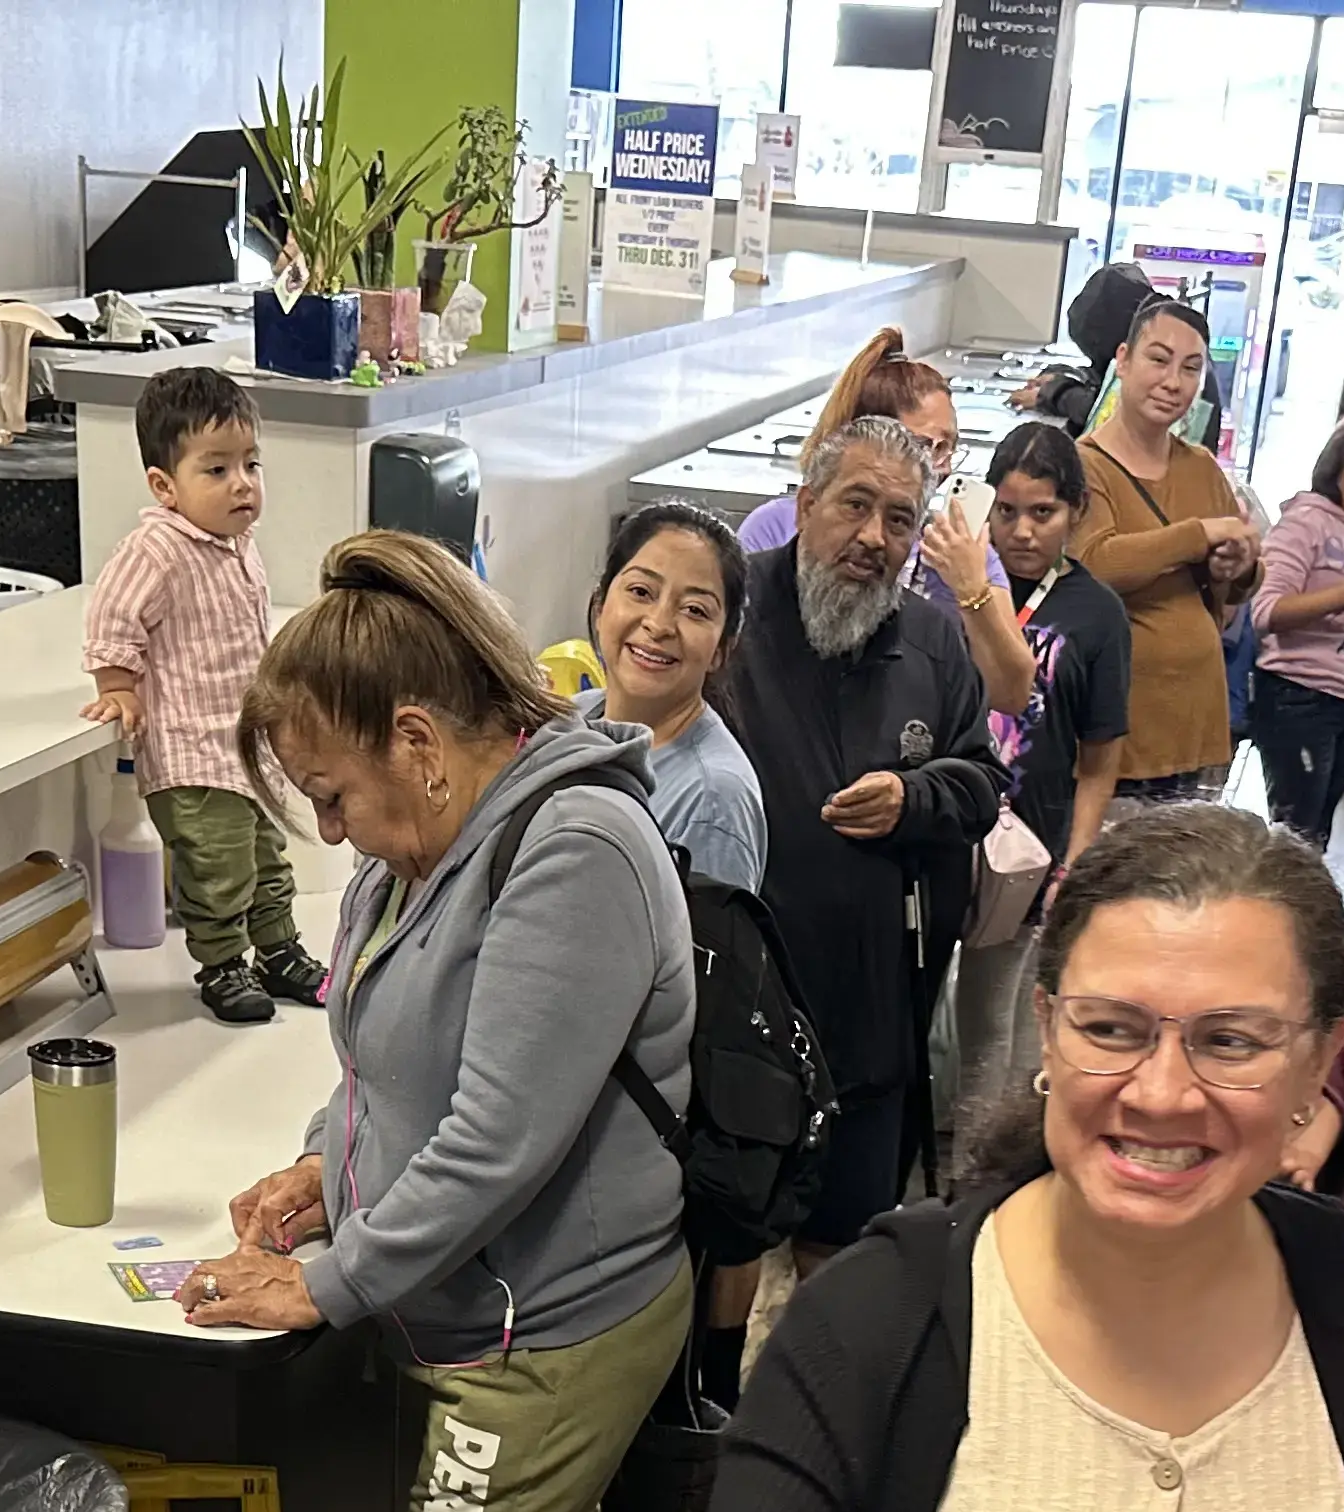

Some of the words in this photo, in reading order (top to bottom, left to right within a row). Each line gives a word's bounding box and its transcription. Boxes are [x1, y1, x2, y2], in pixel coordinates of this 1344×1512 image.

[623, 128, 662, 153] HALF
[662, 131, 707, 157] PRICE
[615, 152, 712, 185] WEDNESDAY!
[617, 245, 649, 266] THRU
[650, 248, 677, 268] DEC.
[678, 251, 700, 270] 31!
